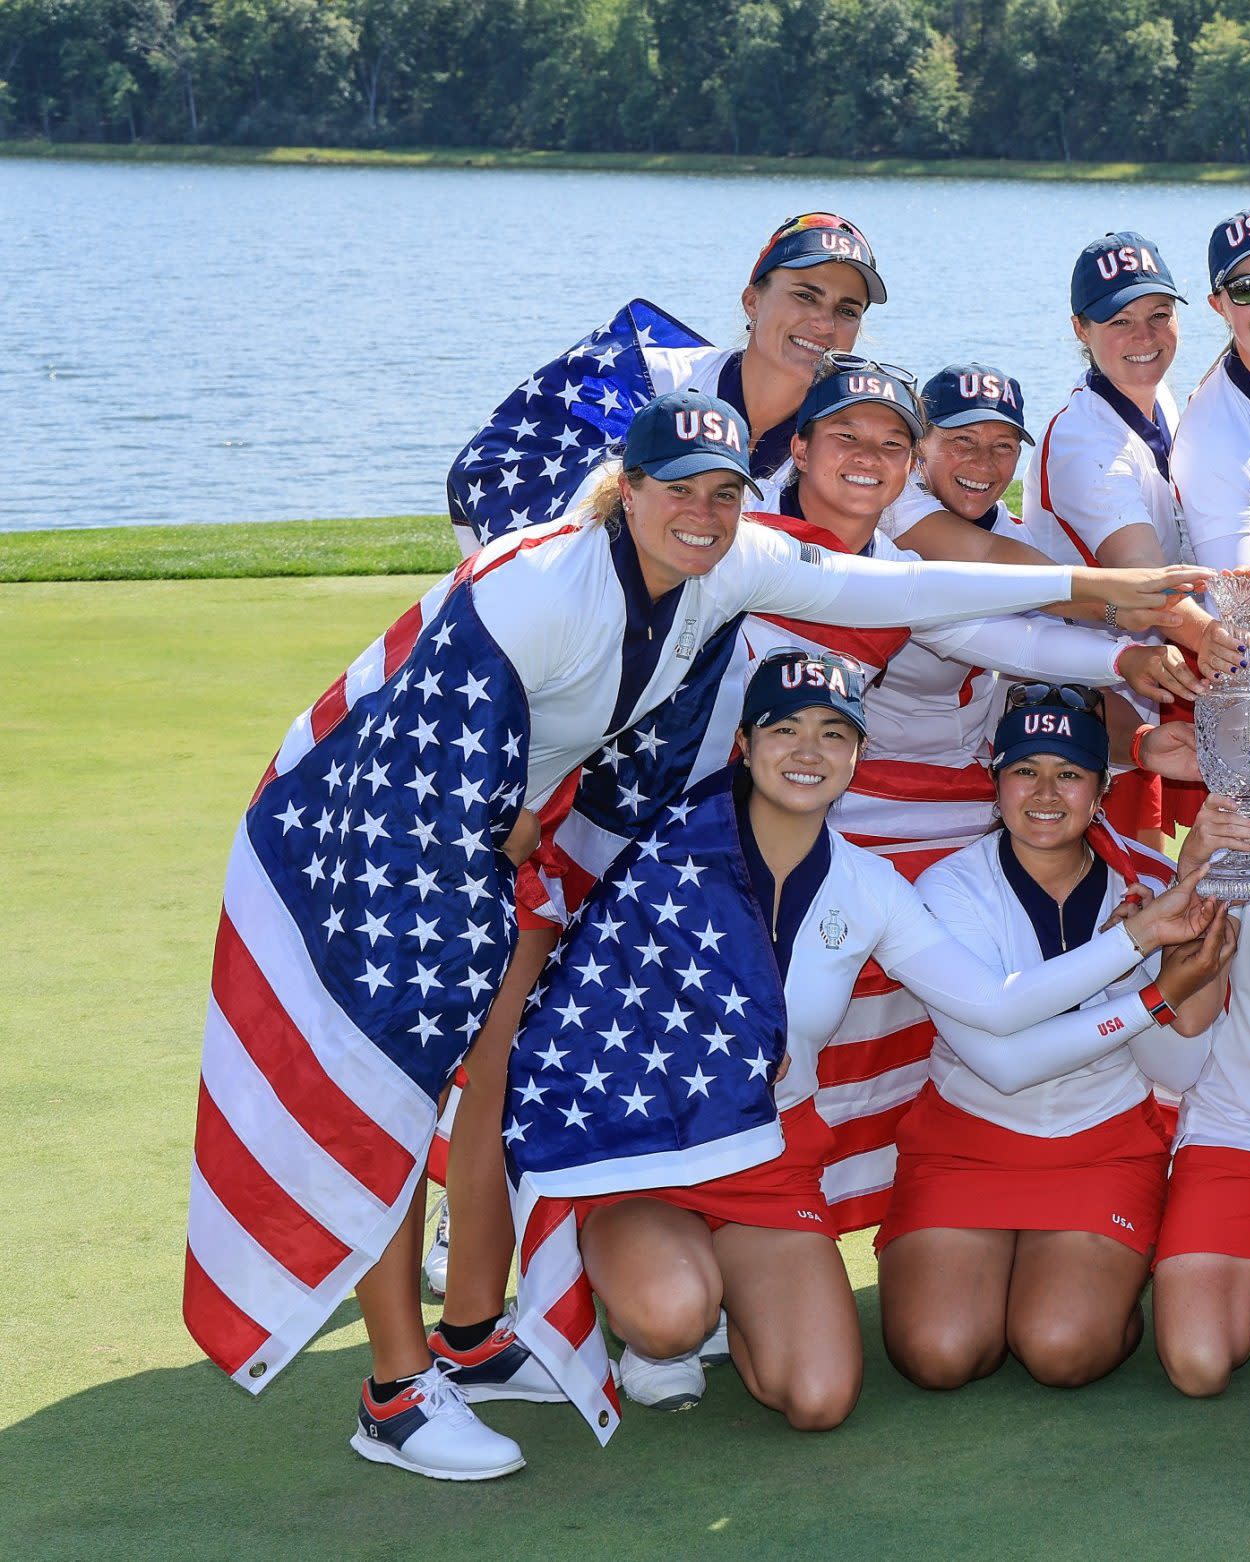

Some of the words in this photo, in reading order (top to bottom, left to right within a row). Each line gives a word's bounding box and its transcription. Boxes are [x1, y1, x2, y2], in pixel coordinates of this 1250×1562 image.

[821, 232, 862, 261] USA
[1096, 247, 1159, 281] USA
[847, 374, 898, 402] USA
[959, 372, 1017, 410] USA
[675, 410, 741, 453] USA
[781, 662, 846, 697] USA
[1024, 713, 1072, 737] USA
[1097, 1016, 1125, 1036] USA
[797, 1210, 822, 1223] USA
[1112, 1213, 1136, 1232] USA
